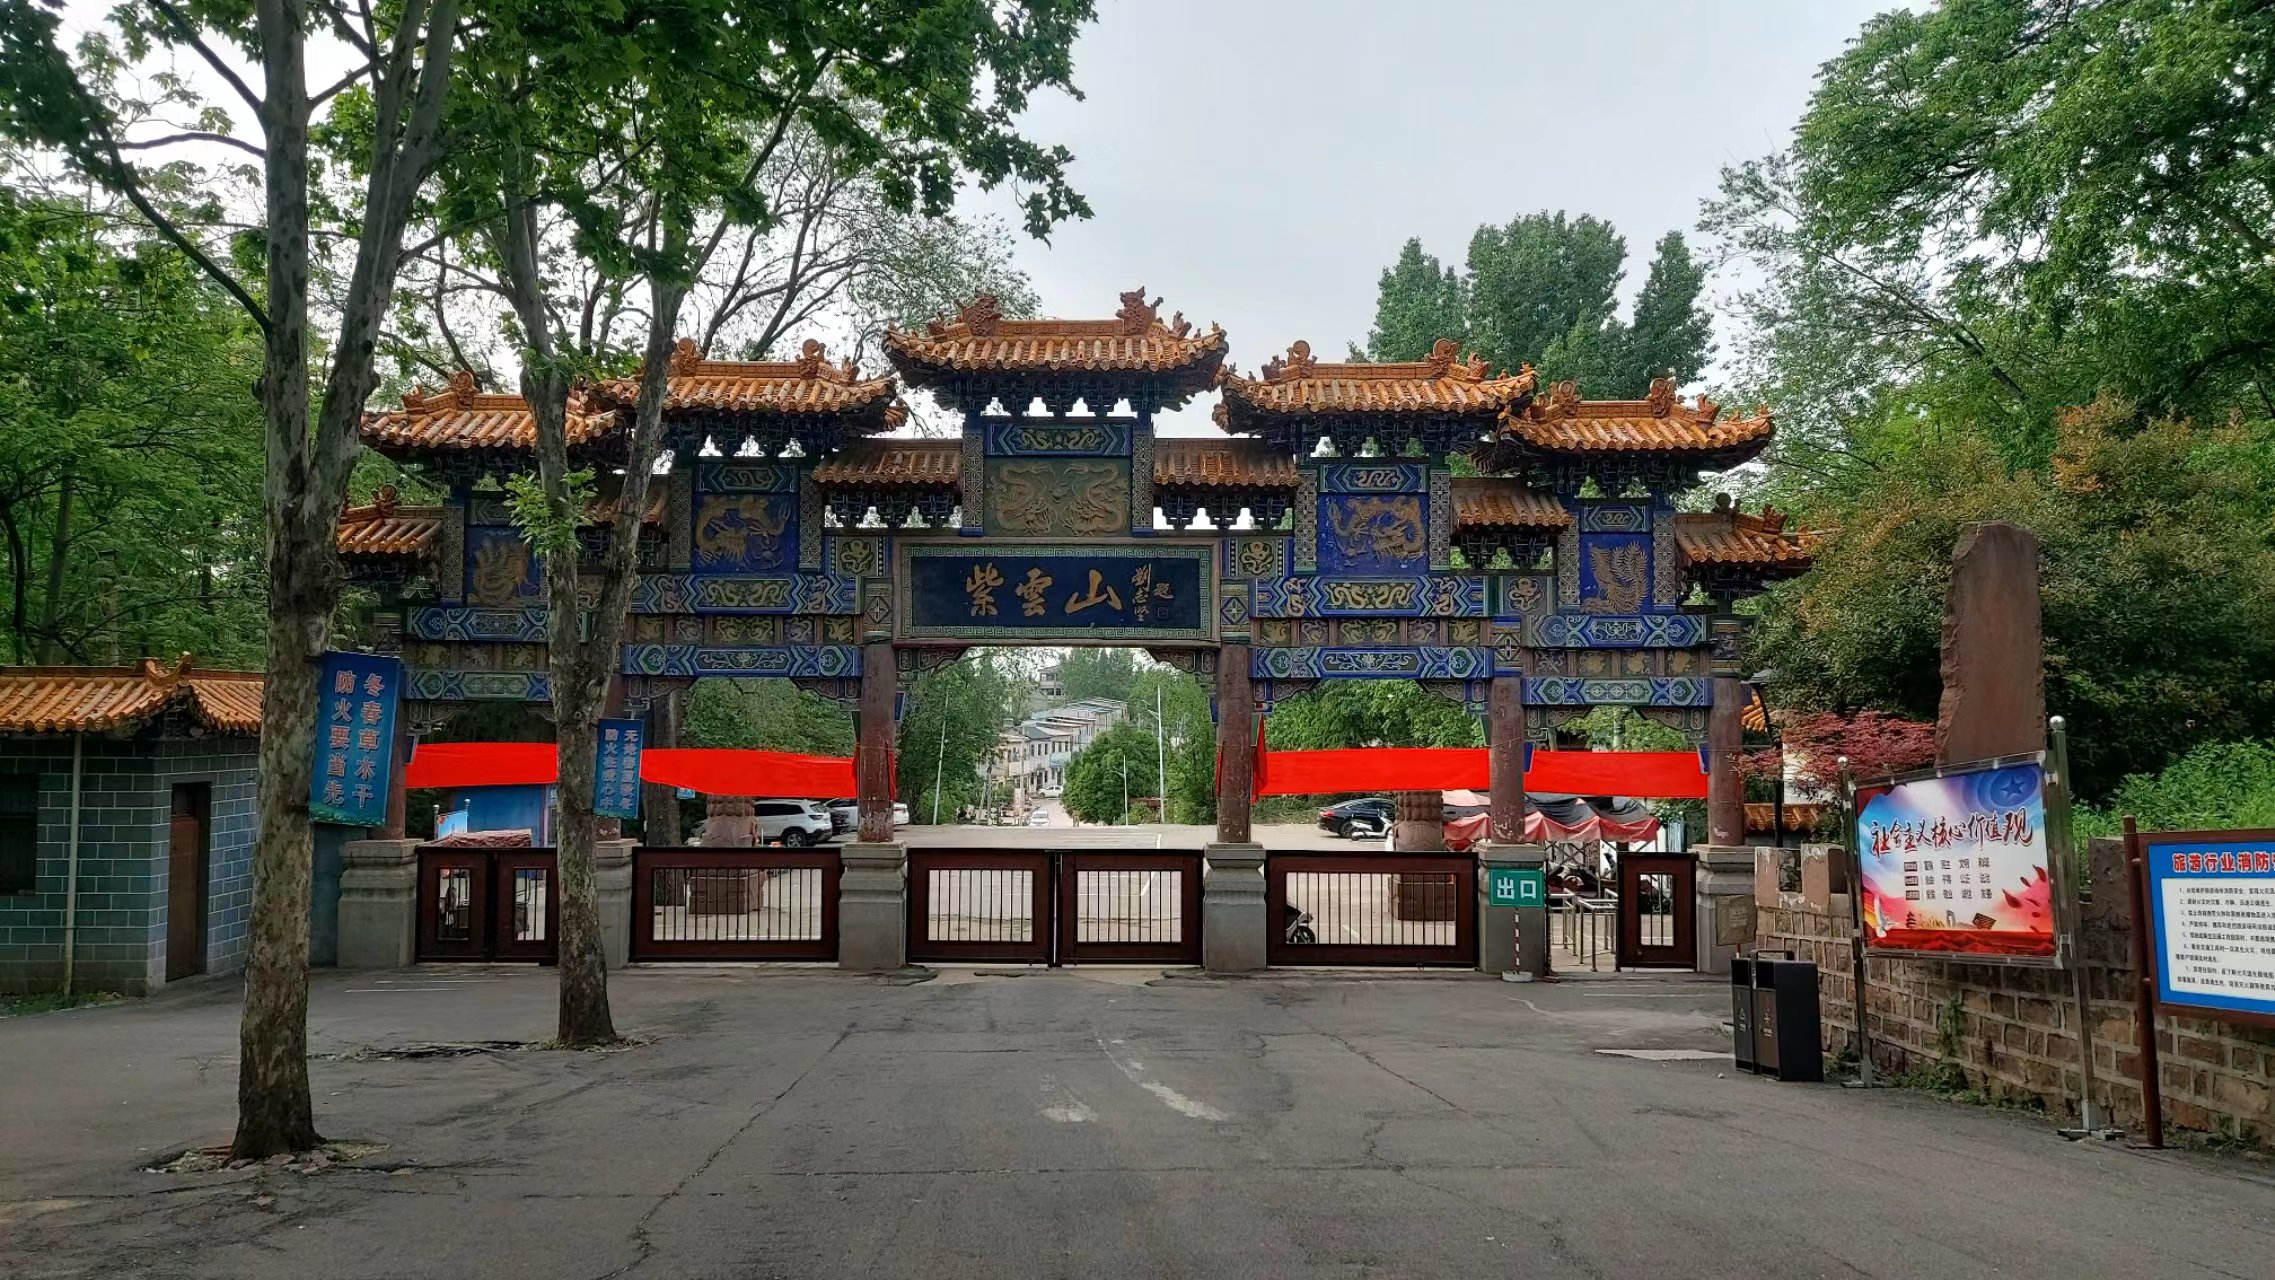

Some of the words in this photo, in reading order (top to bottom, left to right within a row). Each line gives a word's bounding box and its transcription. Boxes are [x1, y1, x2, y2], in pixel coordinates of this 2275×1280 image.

[965, 562, 1123, 617] 紫雲山
[322, 670, 357, 805] 防火要当先
[351, 673, 385, 809] 冬春草木干
[1871, 806, 2034, 859] 社会主义核心价值观
[1497, 877, 1537, 899] 出口
[2172, 851, 2275, 873] 旅游行业消防
